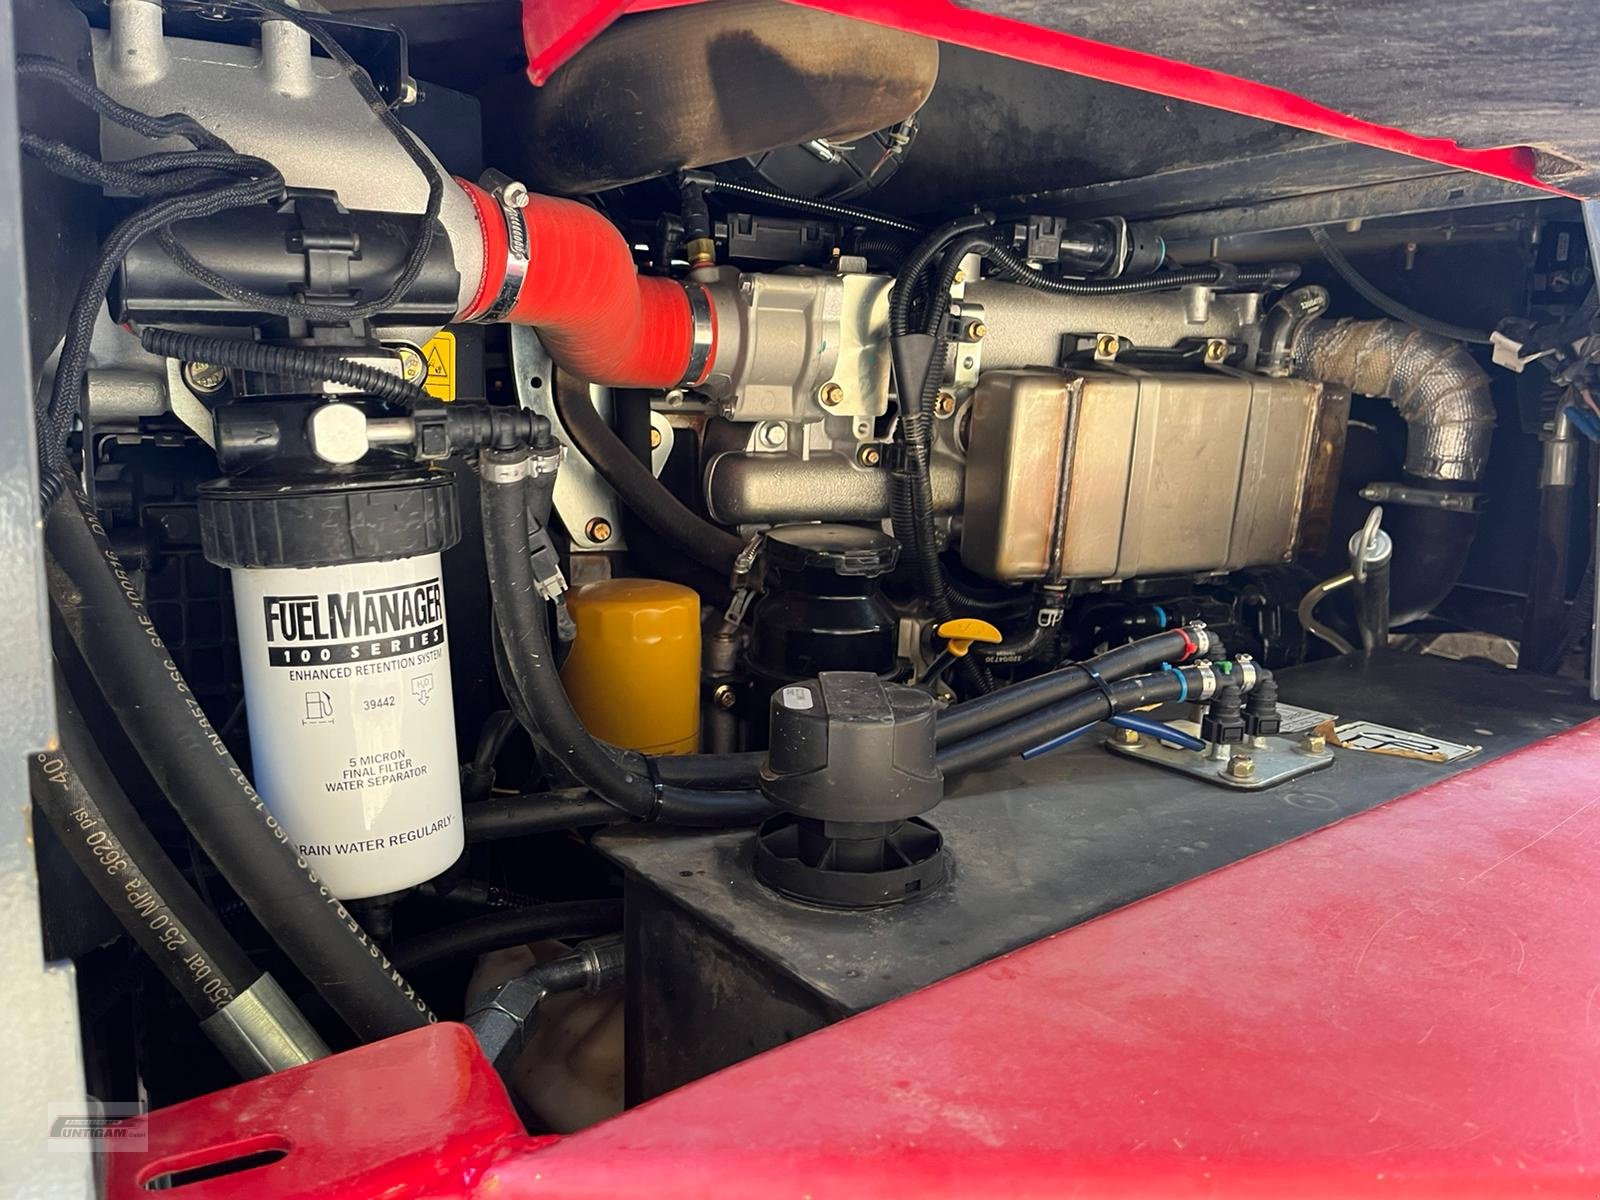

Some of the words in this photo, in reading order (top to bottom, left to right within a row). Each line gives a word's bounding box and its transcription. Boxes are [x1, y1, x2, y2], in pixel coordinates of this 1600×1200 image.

[283, 648, 331, 663] 100
[351, 629, 440, 659] SERIES
[289, 666, 352, 682] ENHANCED
[356, 660, 415, 677] RETENTION
[416, 648, 442, 667] SYSTEM
[363, 696, 396, 711] 39442
[342, 766, 376, 779] FINAL
[379, 758, 412, 775] FILTER
[349, 757, 357, 768] 5
[359, 749, 406, 766] MICRON
[325, 778, 364, 793] WATER
[367, 765, 428, 788] SEPARATOR
[69, 807, 98, 830] psi
[87, 831, 127, 876] 3620
[297, 843, 331, 856] RAIN
[335, 838, 385, 855] WATER
[124, 878, 168, 917] MPa
[150, 915, 188, 951] 25.0
[184, 952, 215, 984] bar
